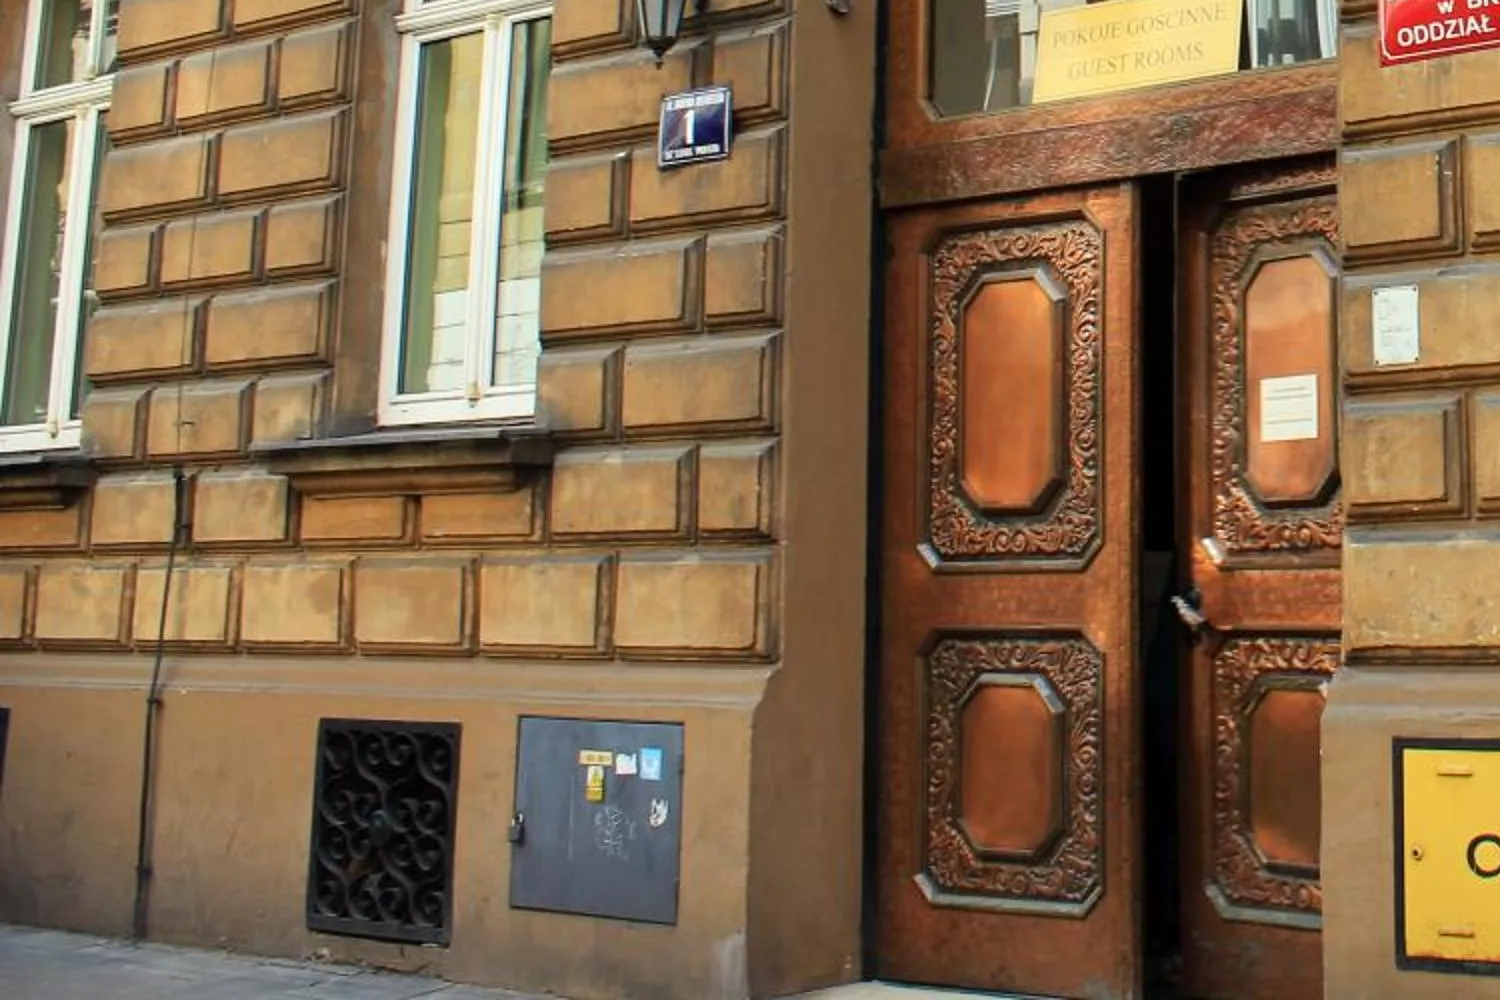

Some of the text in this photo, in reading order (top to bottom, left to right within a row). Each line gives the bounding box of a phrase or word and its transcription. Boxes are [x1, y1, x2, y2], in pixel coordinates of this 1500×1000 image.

[1053, 20, 1123, 49] POKOJE
[1396, 14, 1498, 48] ODDZIAŁ
[1067, 42, 1205, 80] GUEST ROOMS
[683, 109, 696, 145] 1
